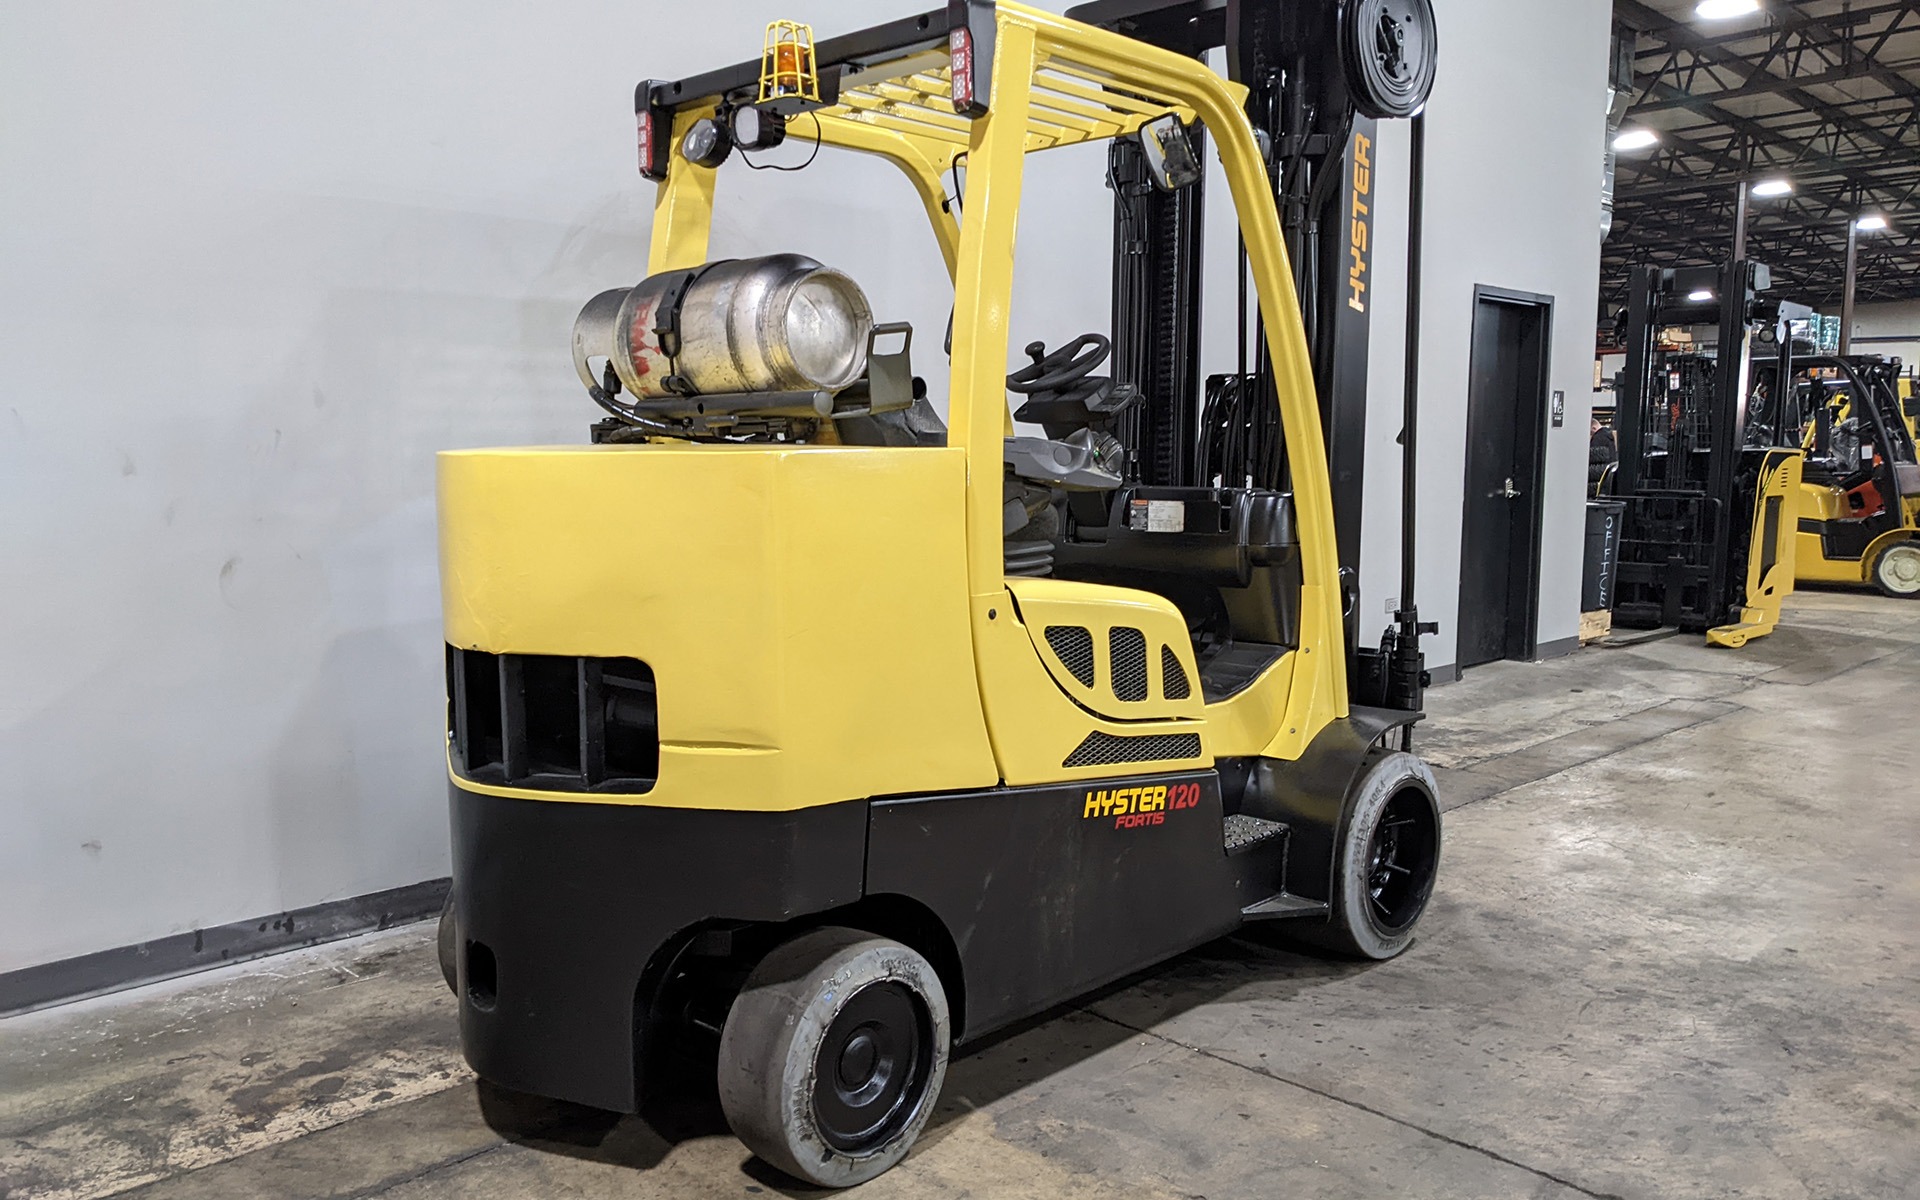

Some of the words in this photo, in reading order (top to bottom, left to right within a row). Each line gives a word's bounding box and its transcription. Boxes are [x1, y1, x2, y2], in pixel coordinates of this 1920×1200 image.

[1349, 132, 1371, 313] HYSTER
[1599, 516, 1613, 607] OFFICE
[1083, 785, 1168, 818] HYSTER
[1167, 782, 1200, 810] 120
[1115, 811, 1165, 830] FORTIS
